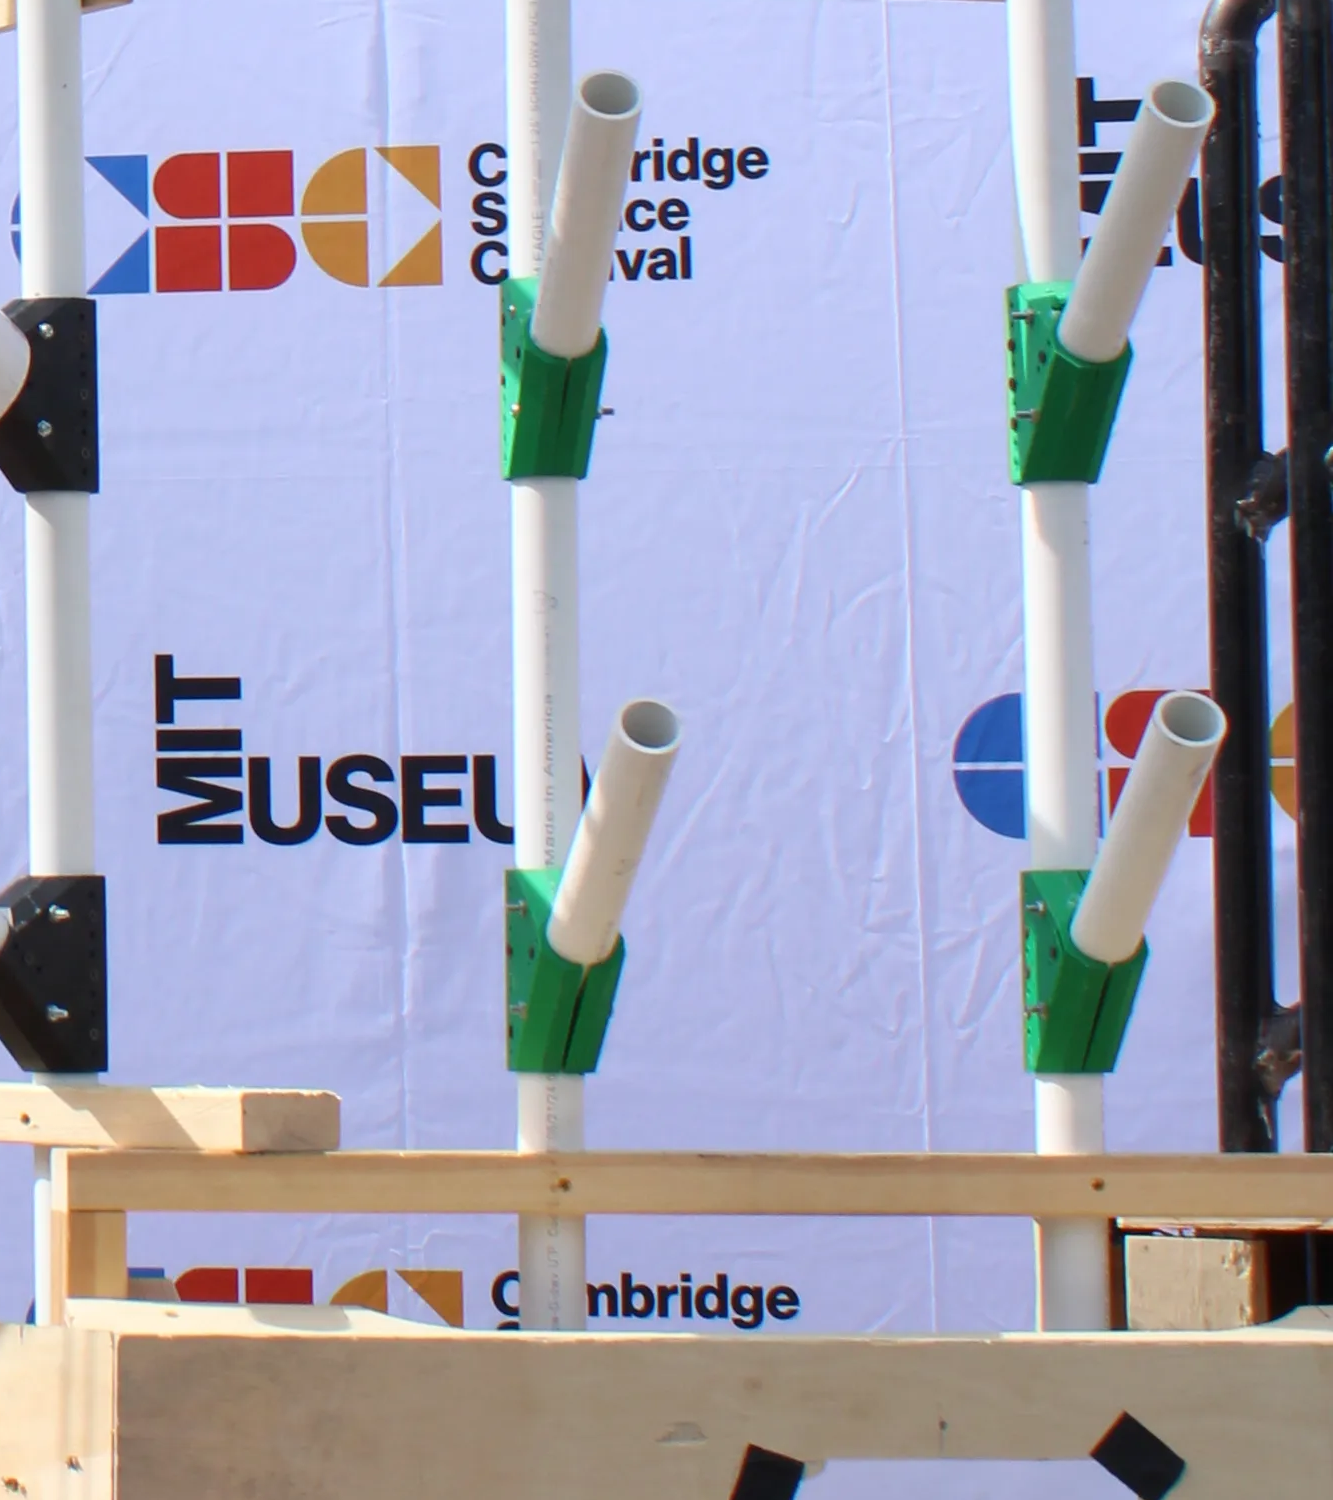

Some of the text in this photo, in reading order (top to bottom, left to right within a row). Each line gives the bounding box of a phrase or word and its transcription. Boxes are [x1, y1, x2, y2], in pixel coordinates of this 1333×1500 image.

[467, 136, 770, 191] Cridge
[154, 653, 244, 845] MIT
[490, 1270, 801, 1330] Cmbridge
